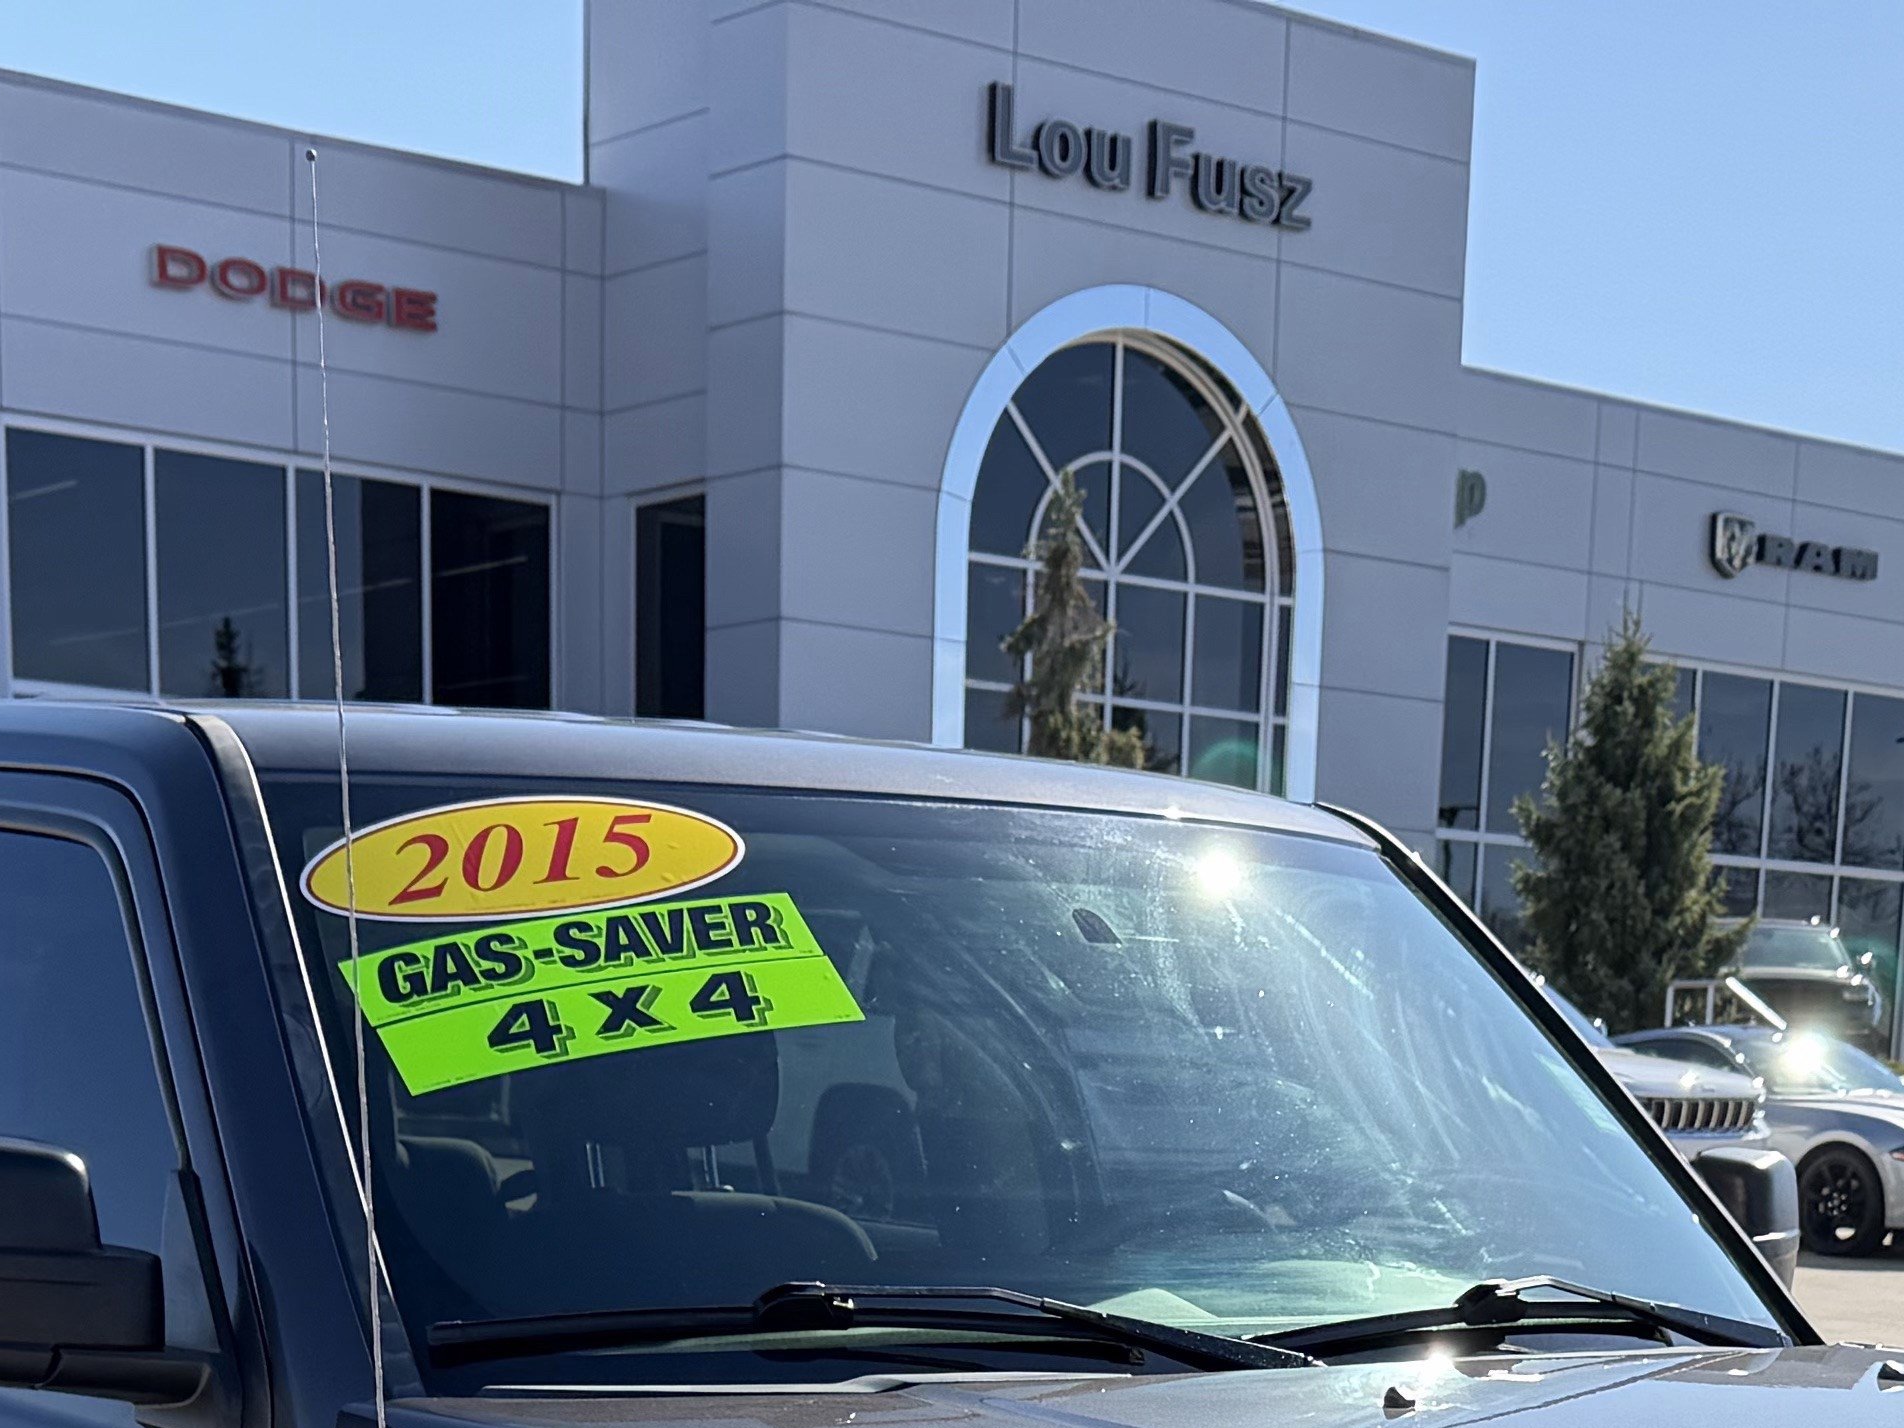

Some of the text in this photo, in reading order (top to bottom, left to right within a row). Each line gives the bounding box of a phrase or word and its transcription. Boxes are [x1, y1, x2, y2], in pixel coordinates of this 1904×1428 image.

[988, 80, 1313, 229] Lou Fusz
[151, 243, 438, 332] DODGE
[1756, 534, 1878, 580] RAM
[389, 815, 652, 903] 2015
[377, 902, 793, 1008] GAS-SAVER
